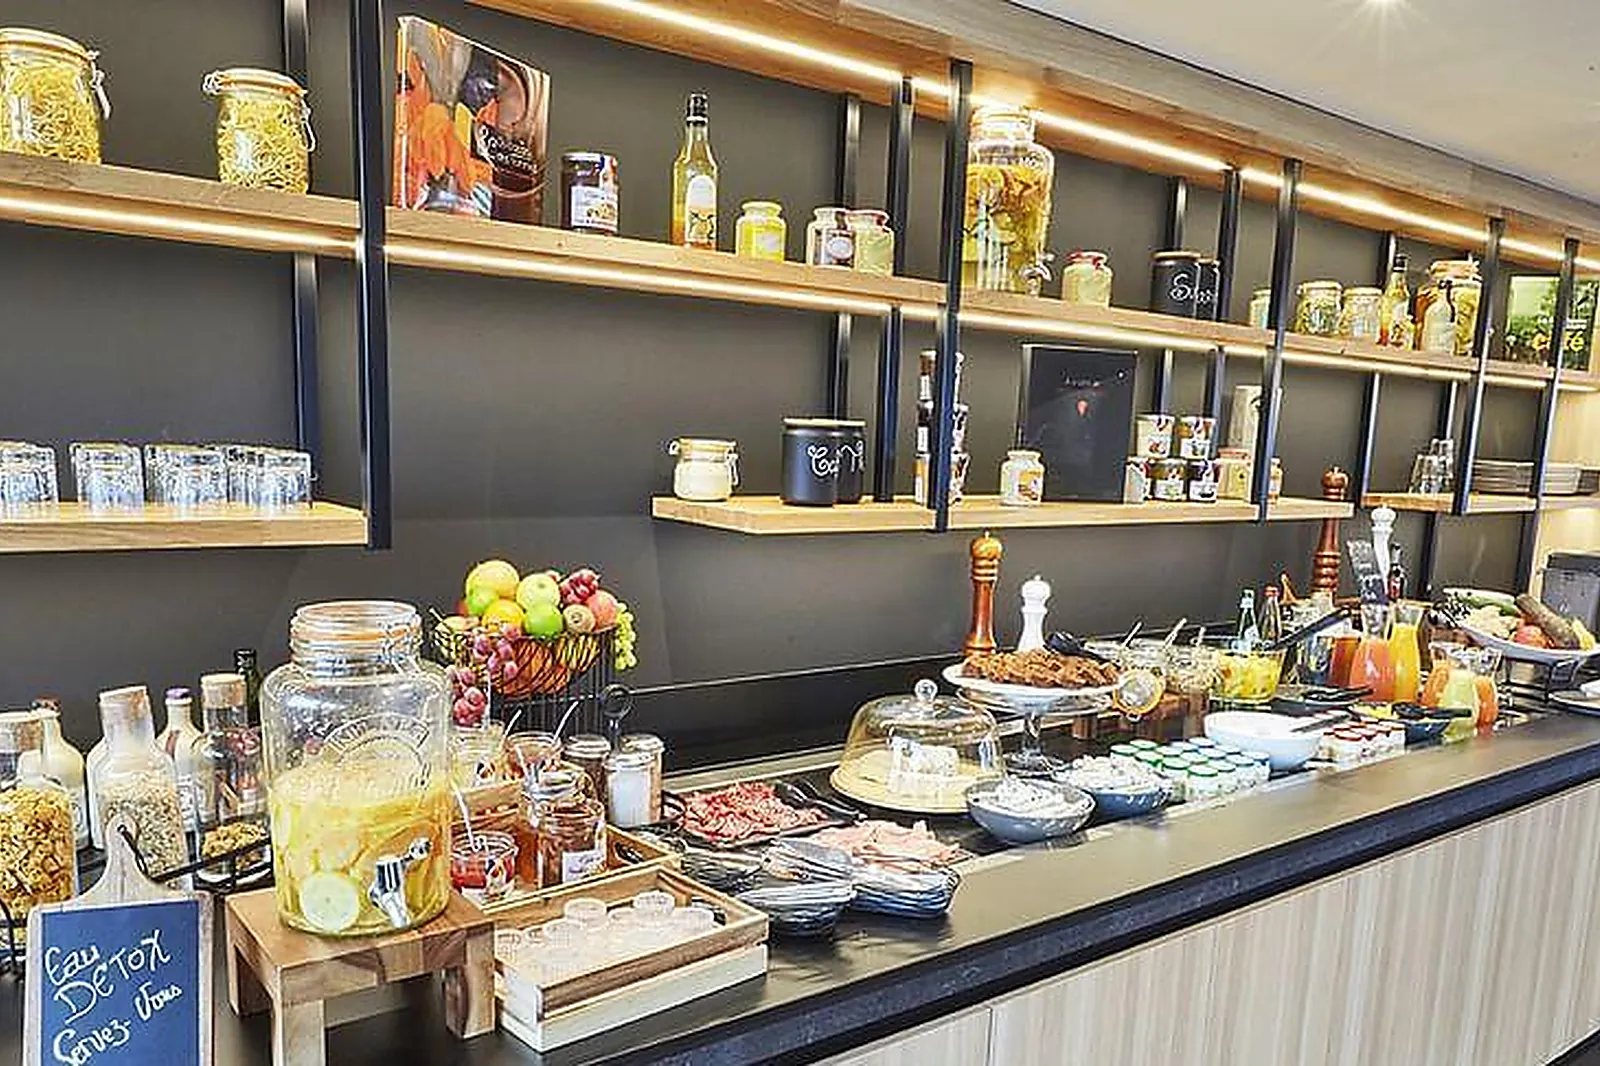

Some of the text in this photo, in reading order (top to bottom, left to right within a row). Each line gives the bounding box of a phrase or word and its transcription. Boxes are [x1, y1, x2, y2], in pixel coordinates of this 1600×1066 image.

[45, 945, 99, 986] Eau
[54, 930, 171, 1025] DETOX
[135, 981, 183, 1021] Vous
